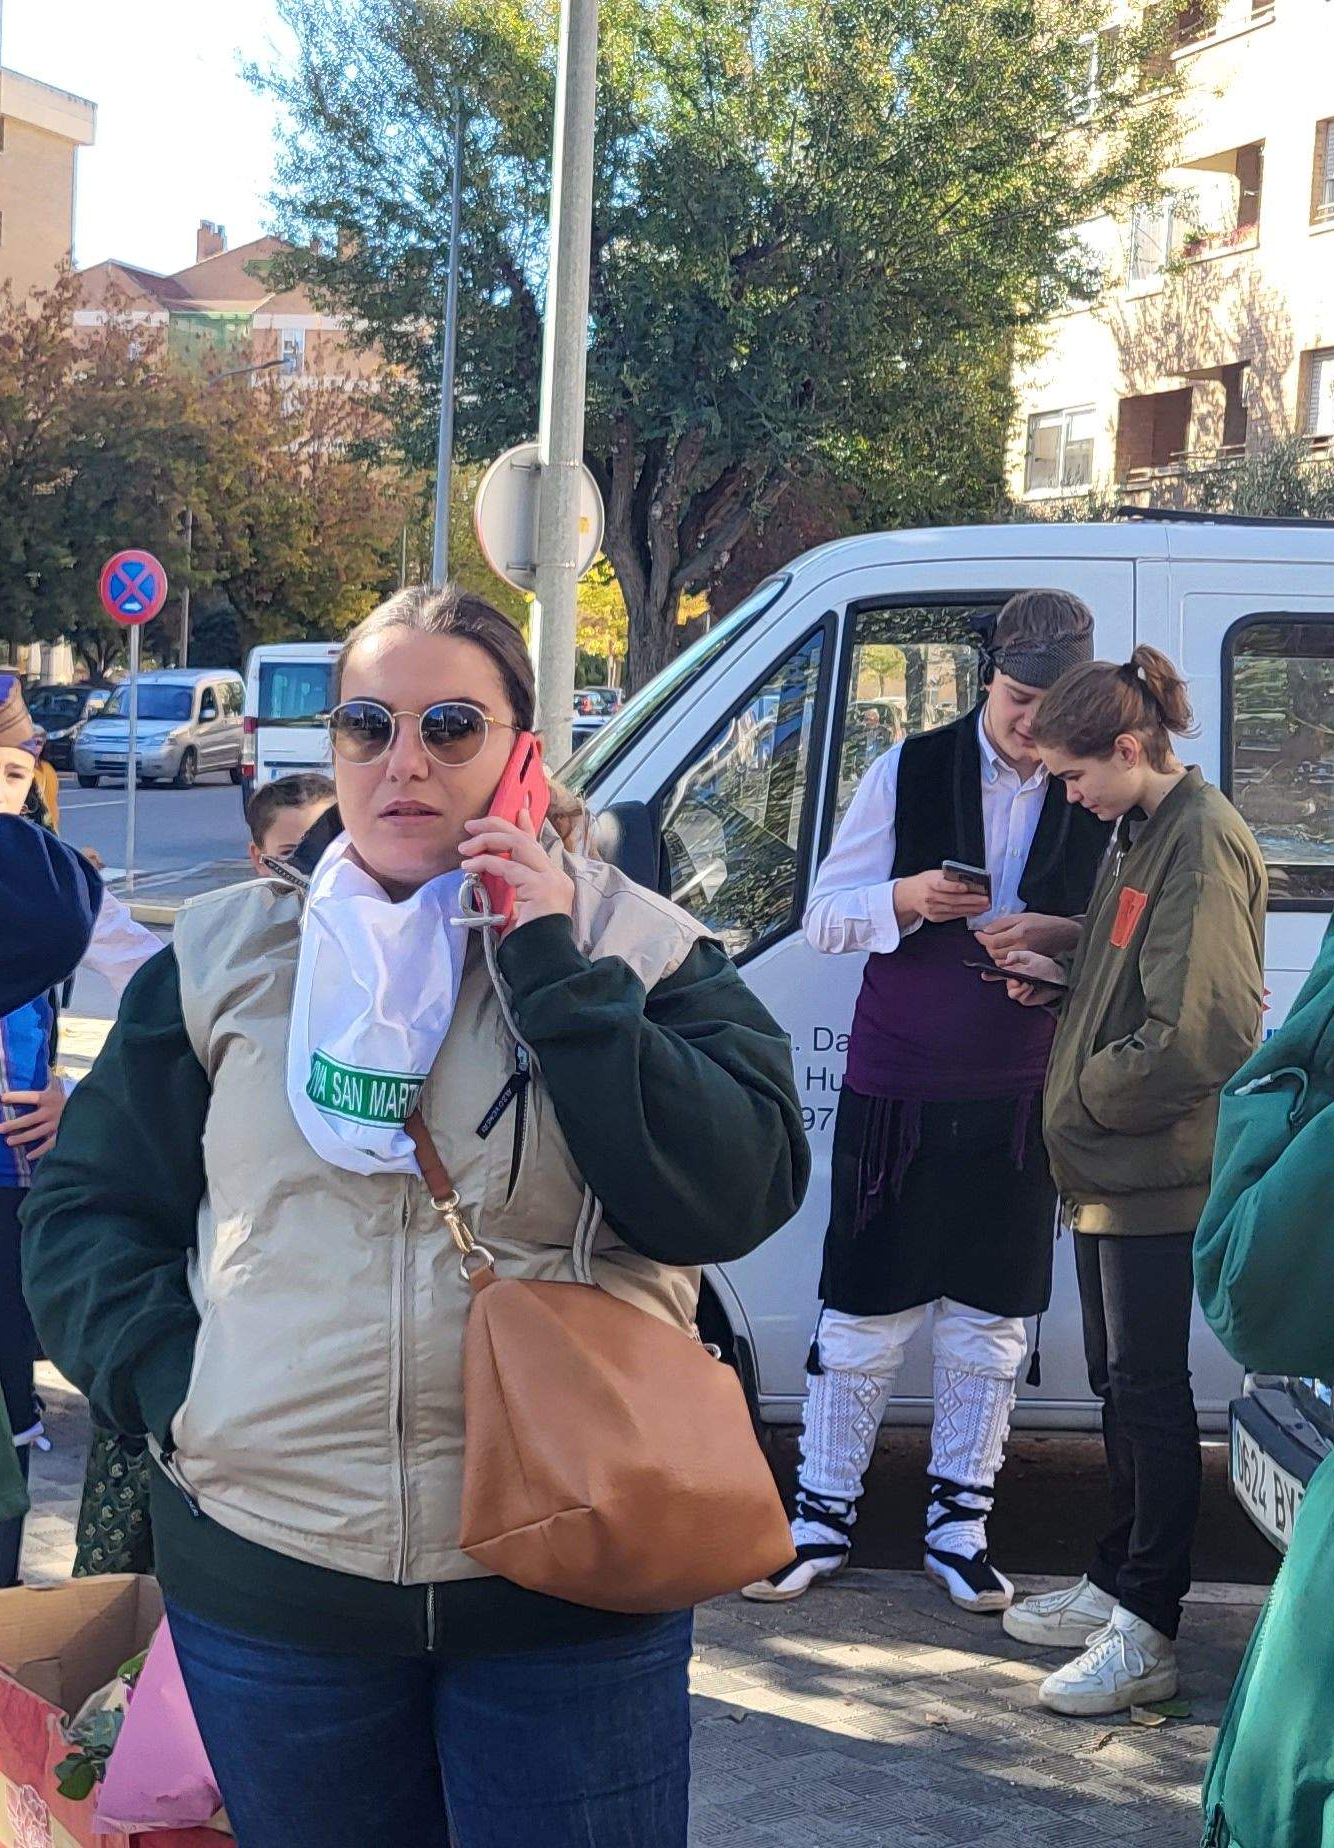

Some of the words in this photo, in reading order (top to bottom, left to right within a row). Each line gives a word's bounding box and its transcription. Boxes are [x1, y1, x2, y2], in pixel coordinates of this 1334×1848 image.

[813, 1026, 850, 1053] Da
[331, 1071, 364, 1113] SAN
[806, 1066, 843, 1092] Hu
[802, 1106, 835, 1131] 97
[1237, 1429, 1267, 1517] 0624
[1273, 1470, 1303, 1534] BY
